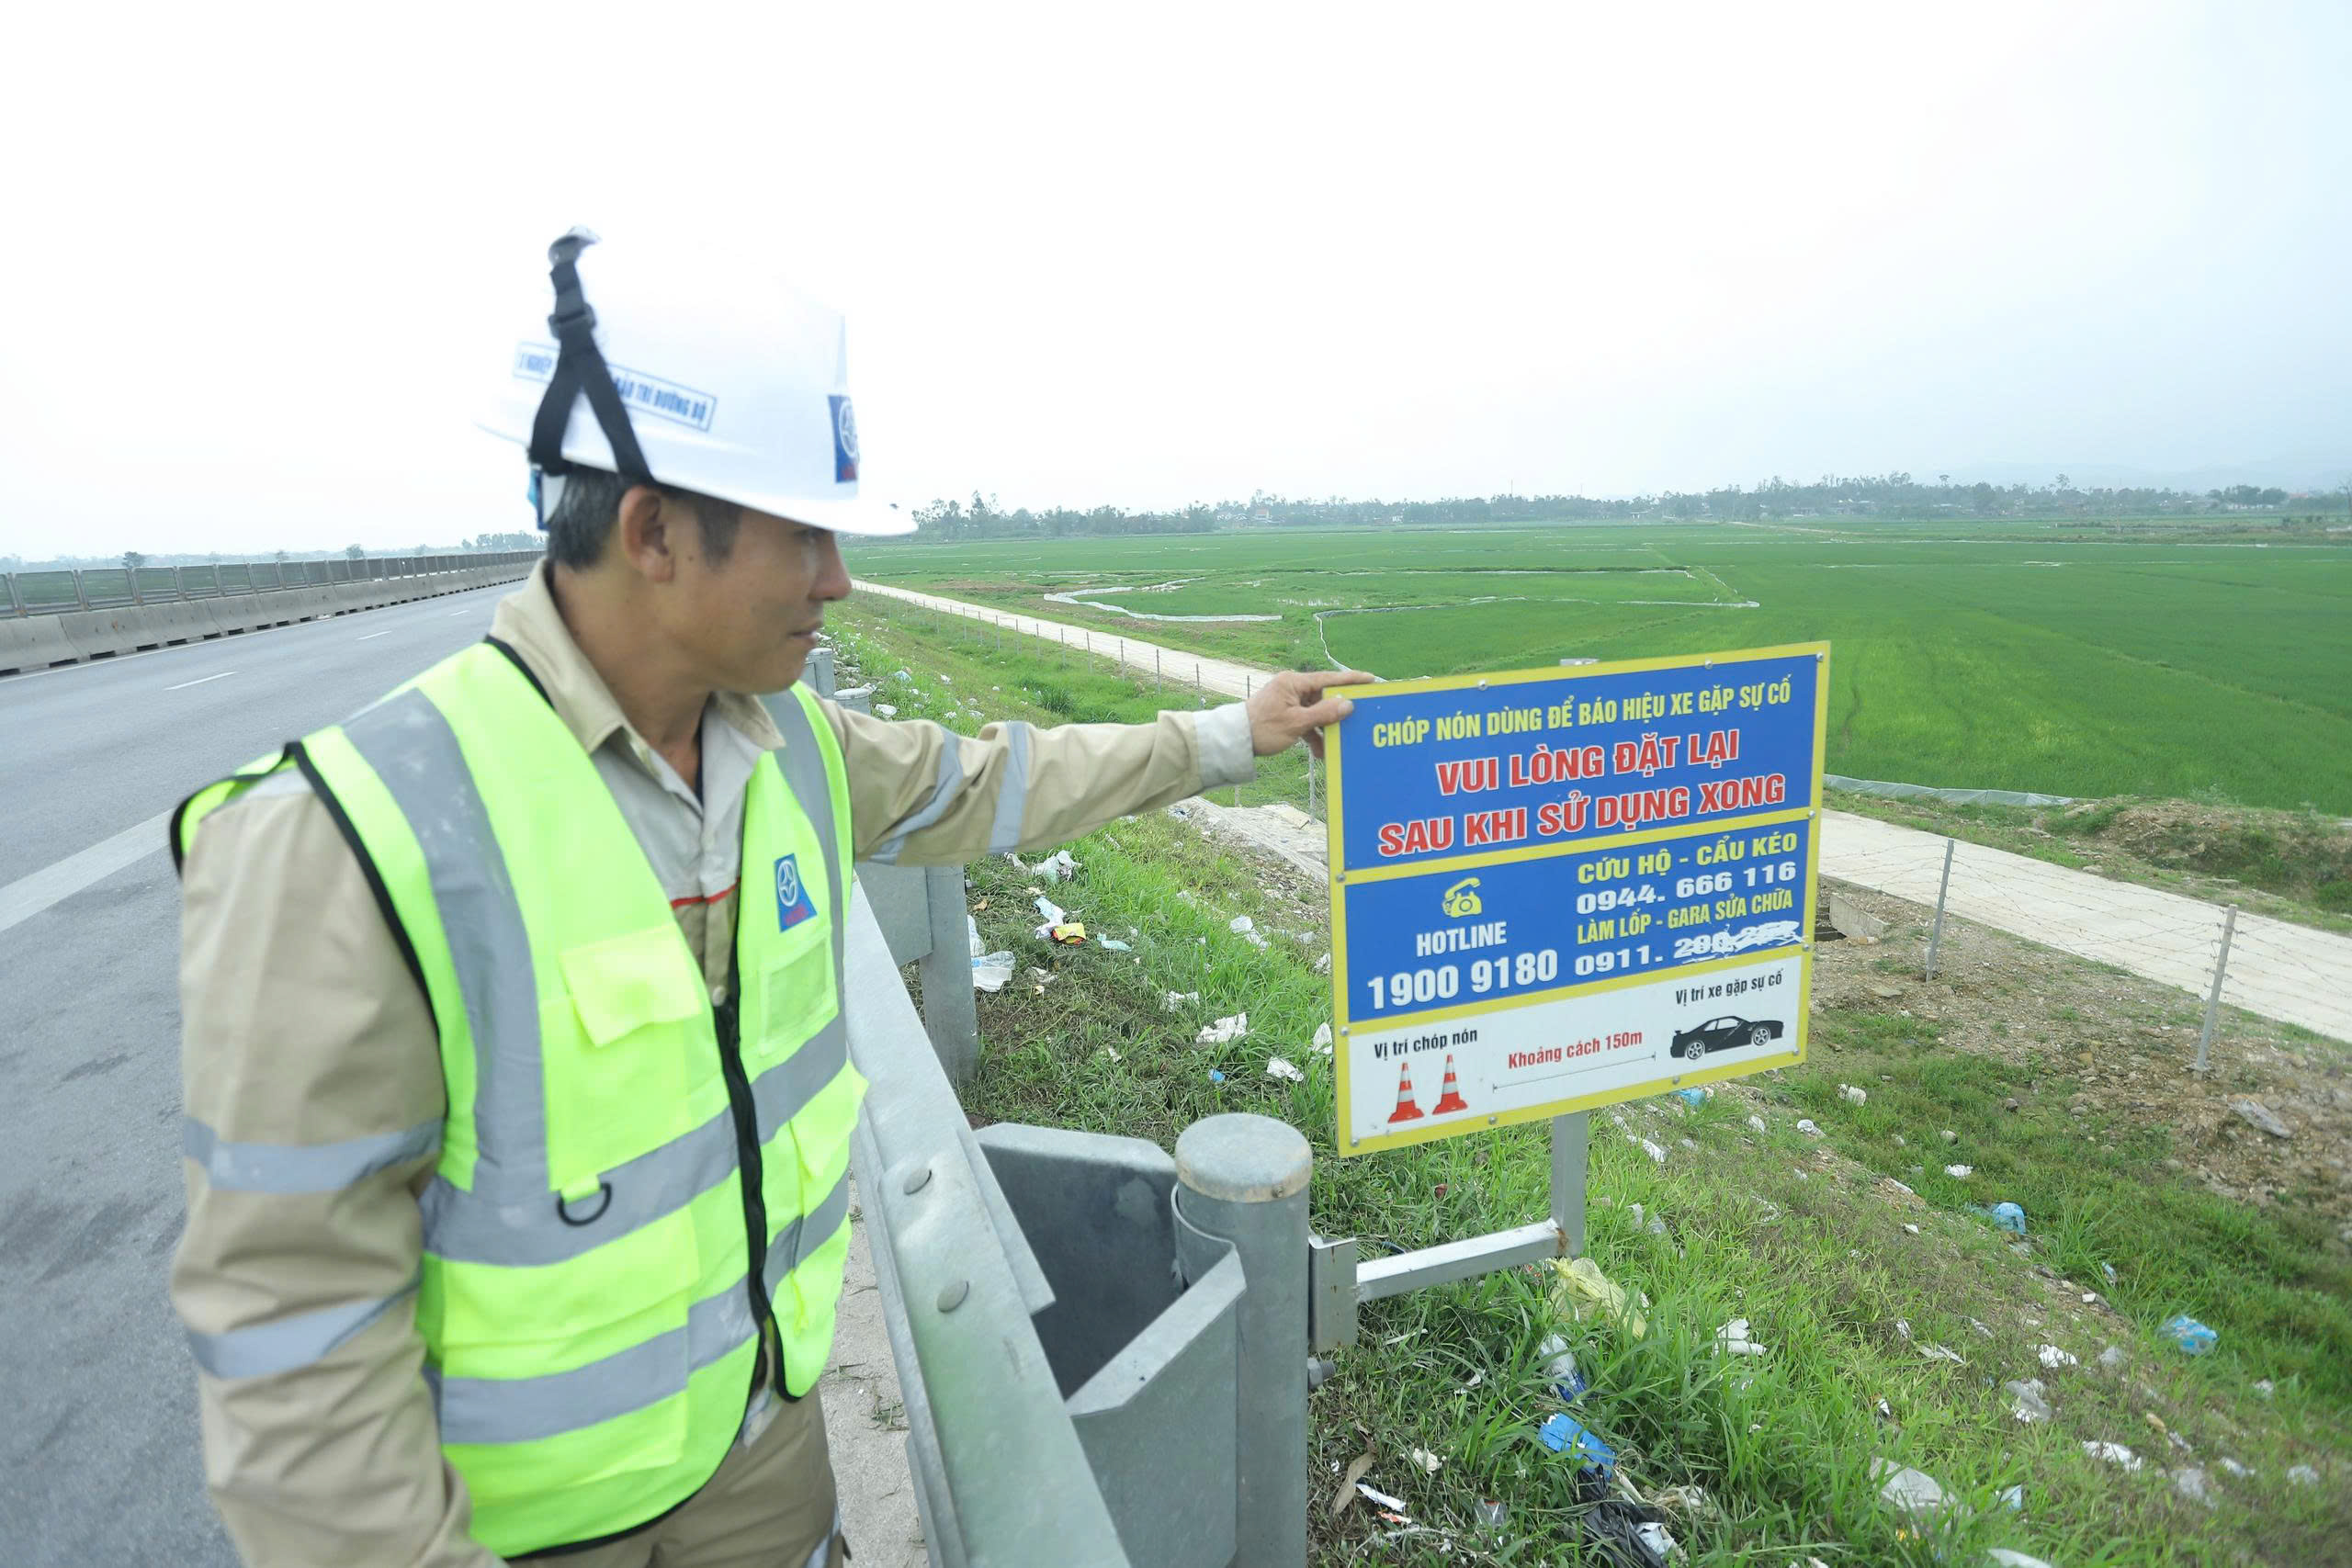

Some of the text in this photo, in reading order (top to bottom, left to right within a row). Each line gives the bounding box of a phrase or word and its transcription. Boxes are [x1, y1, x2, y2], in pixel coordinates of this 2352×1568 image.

[1373, 673, 1792, 748] CHÓP NÓN DÙNG ĐỂ BÁO HIỆU XE GẶP SỰ CỐ
[1434, 728, 1740, 796] VUI LÒNG ĐẶT LẠI
[1377, 773, 1787, 858] SAU KHI SỬ DỤNG XONG
[1577, 856, 1630, 885] CỨU
[1638, 848, 1671, 876] HỘ
[1696, 835, 1746, 866] CẨU
[1751, 830, 1798, 858] KÉO
[1576, 861, 1796, 915] 0944. 666 116
[1416, 920, 1508, 957] HOTLINE
[1577, 916, 1614, 945] LÀM
[1619, 908, 1652, 938] LỐP
[1668, 905, 1710, 930] GARA
[1714, 893, 1747, 920] SỬA
[1751, 887, 1793, 915] CHỮA
[1368, 949, 1559, 1010] 1900 9180
[1575, 945, 1663, 977] 0911.
[1676, 970, 1782, 1005] Vị trí xe gặp sự cố
[1374, 1028, 1477, 1059] Vị trí chóp nón
[1509, 1032, 1643, 1069] Khoảng cách 150m
